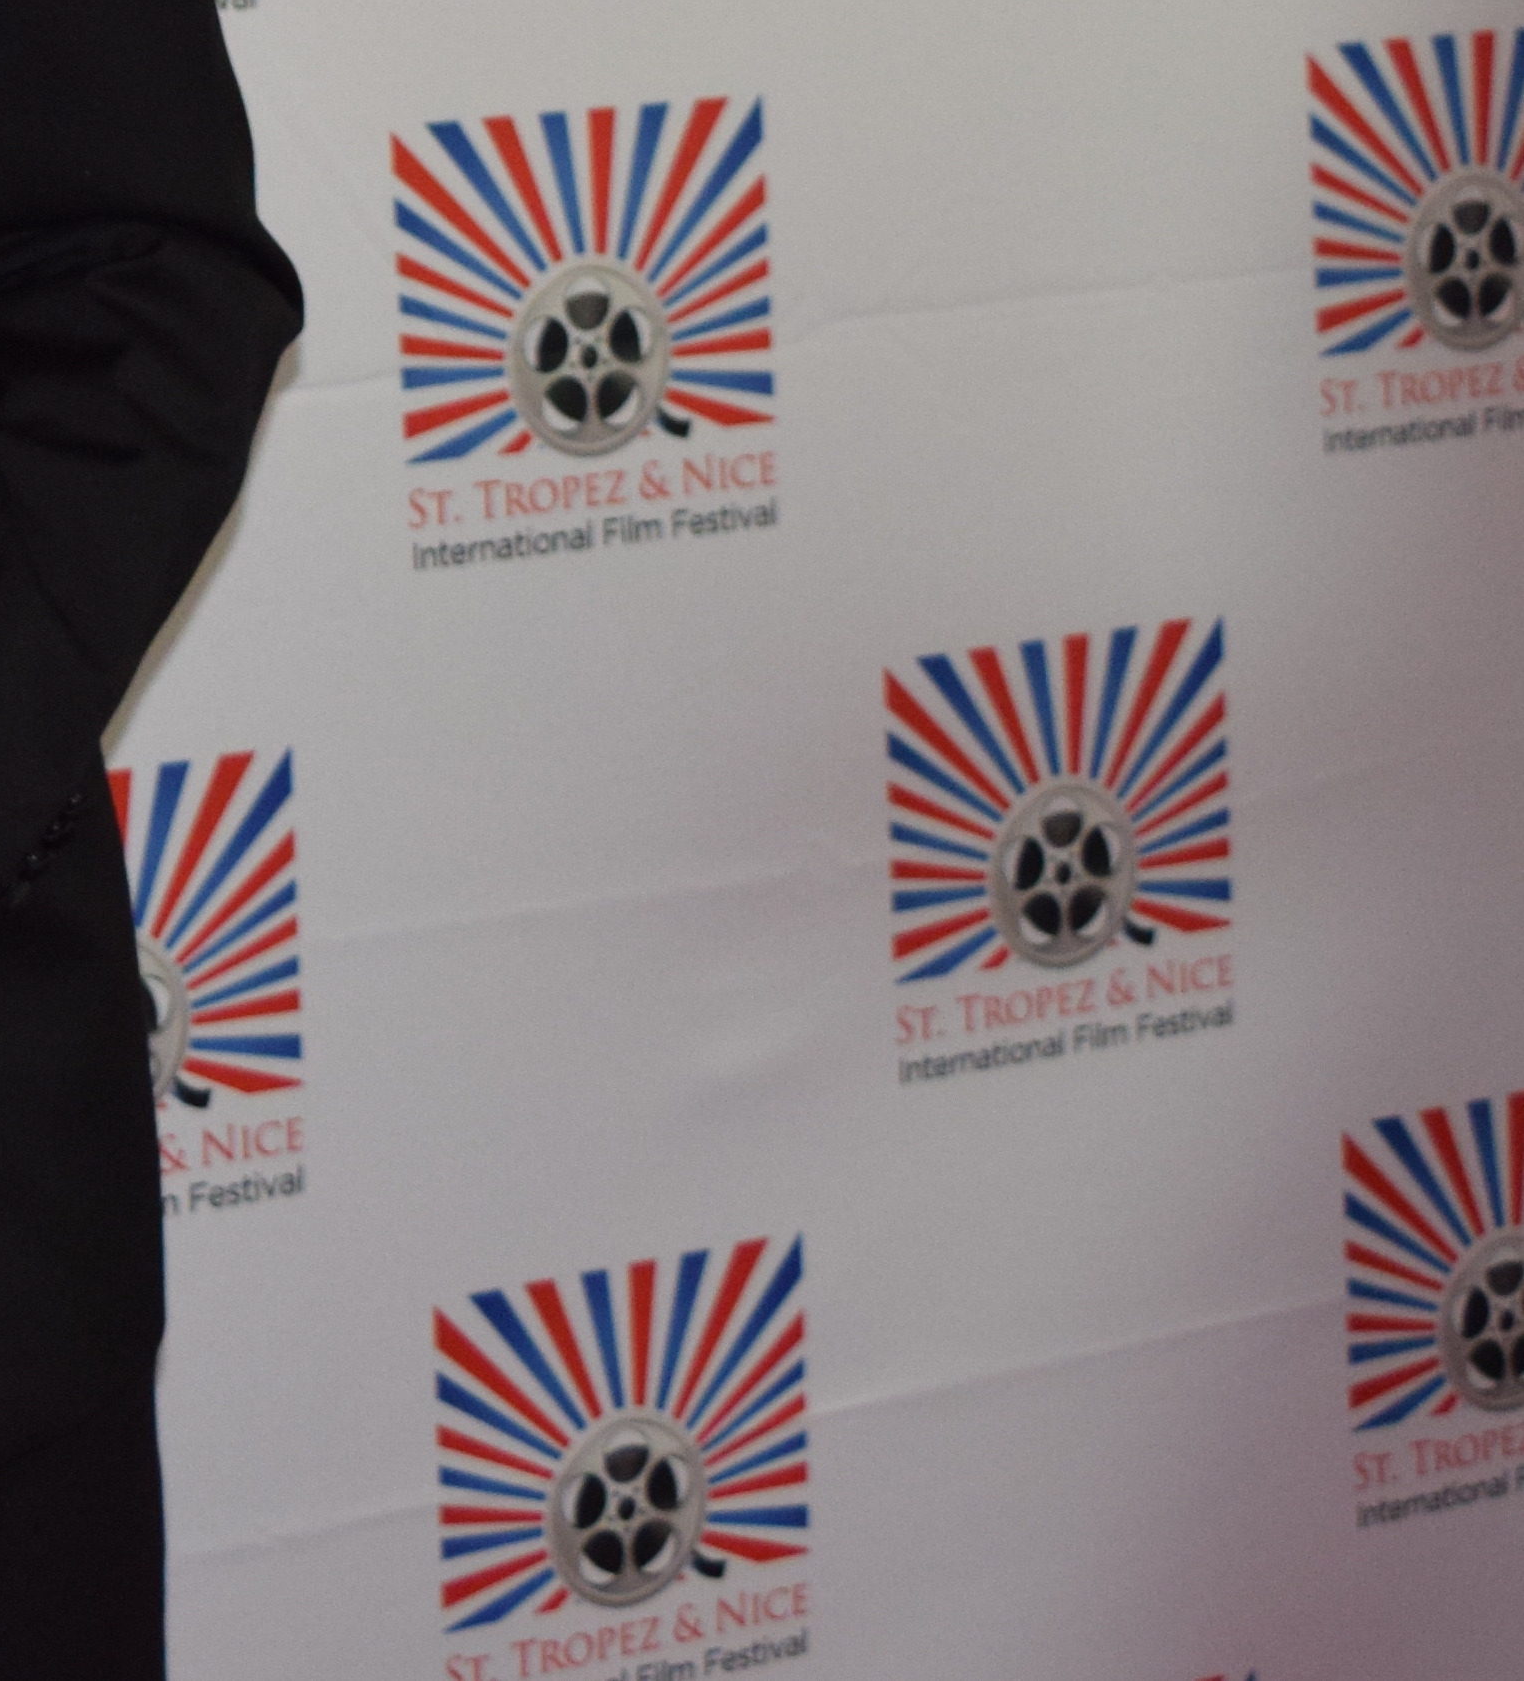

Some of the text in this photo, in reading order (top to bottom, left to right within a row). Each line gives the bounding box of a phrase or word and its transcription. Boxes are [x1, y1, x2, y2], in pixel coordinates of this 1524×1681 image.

[474, 469, 628, 520] TROPEZ
[638, 461, 673, 502] &
[681, 451, 777, 495] NICE
[414, 500, 778, 569] International Film Festival
[956, 977, 1096, 1033] TROPEZ
[1107, 970, 1137, 1008] &
[1145, 955, 1233, 997] NICE
[901, 1002, 1235, 1083] International Film Festival
[202, 1116, 305, 1168] NICE
[189, 1165, 307, 1212] Festival
[513, 1616, 661, 1678] TROPEZ
[673, 1611, 705, 1644] &
[716, 1585, 807, 1632] NICE
[705, 1630, 809, 1675] Festival
